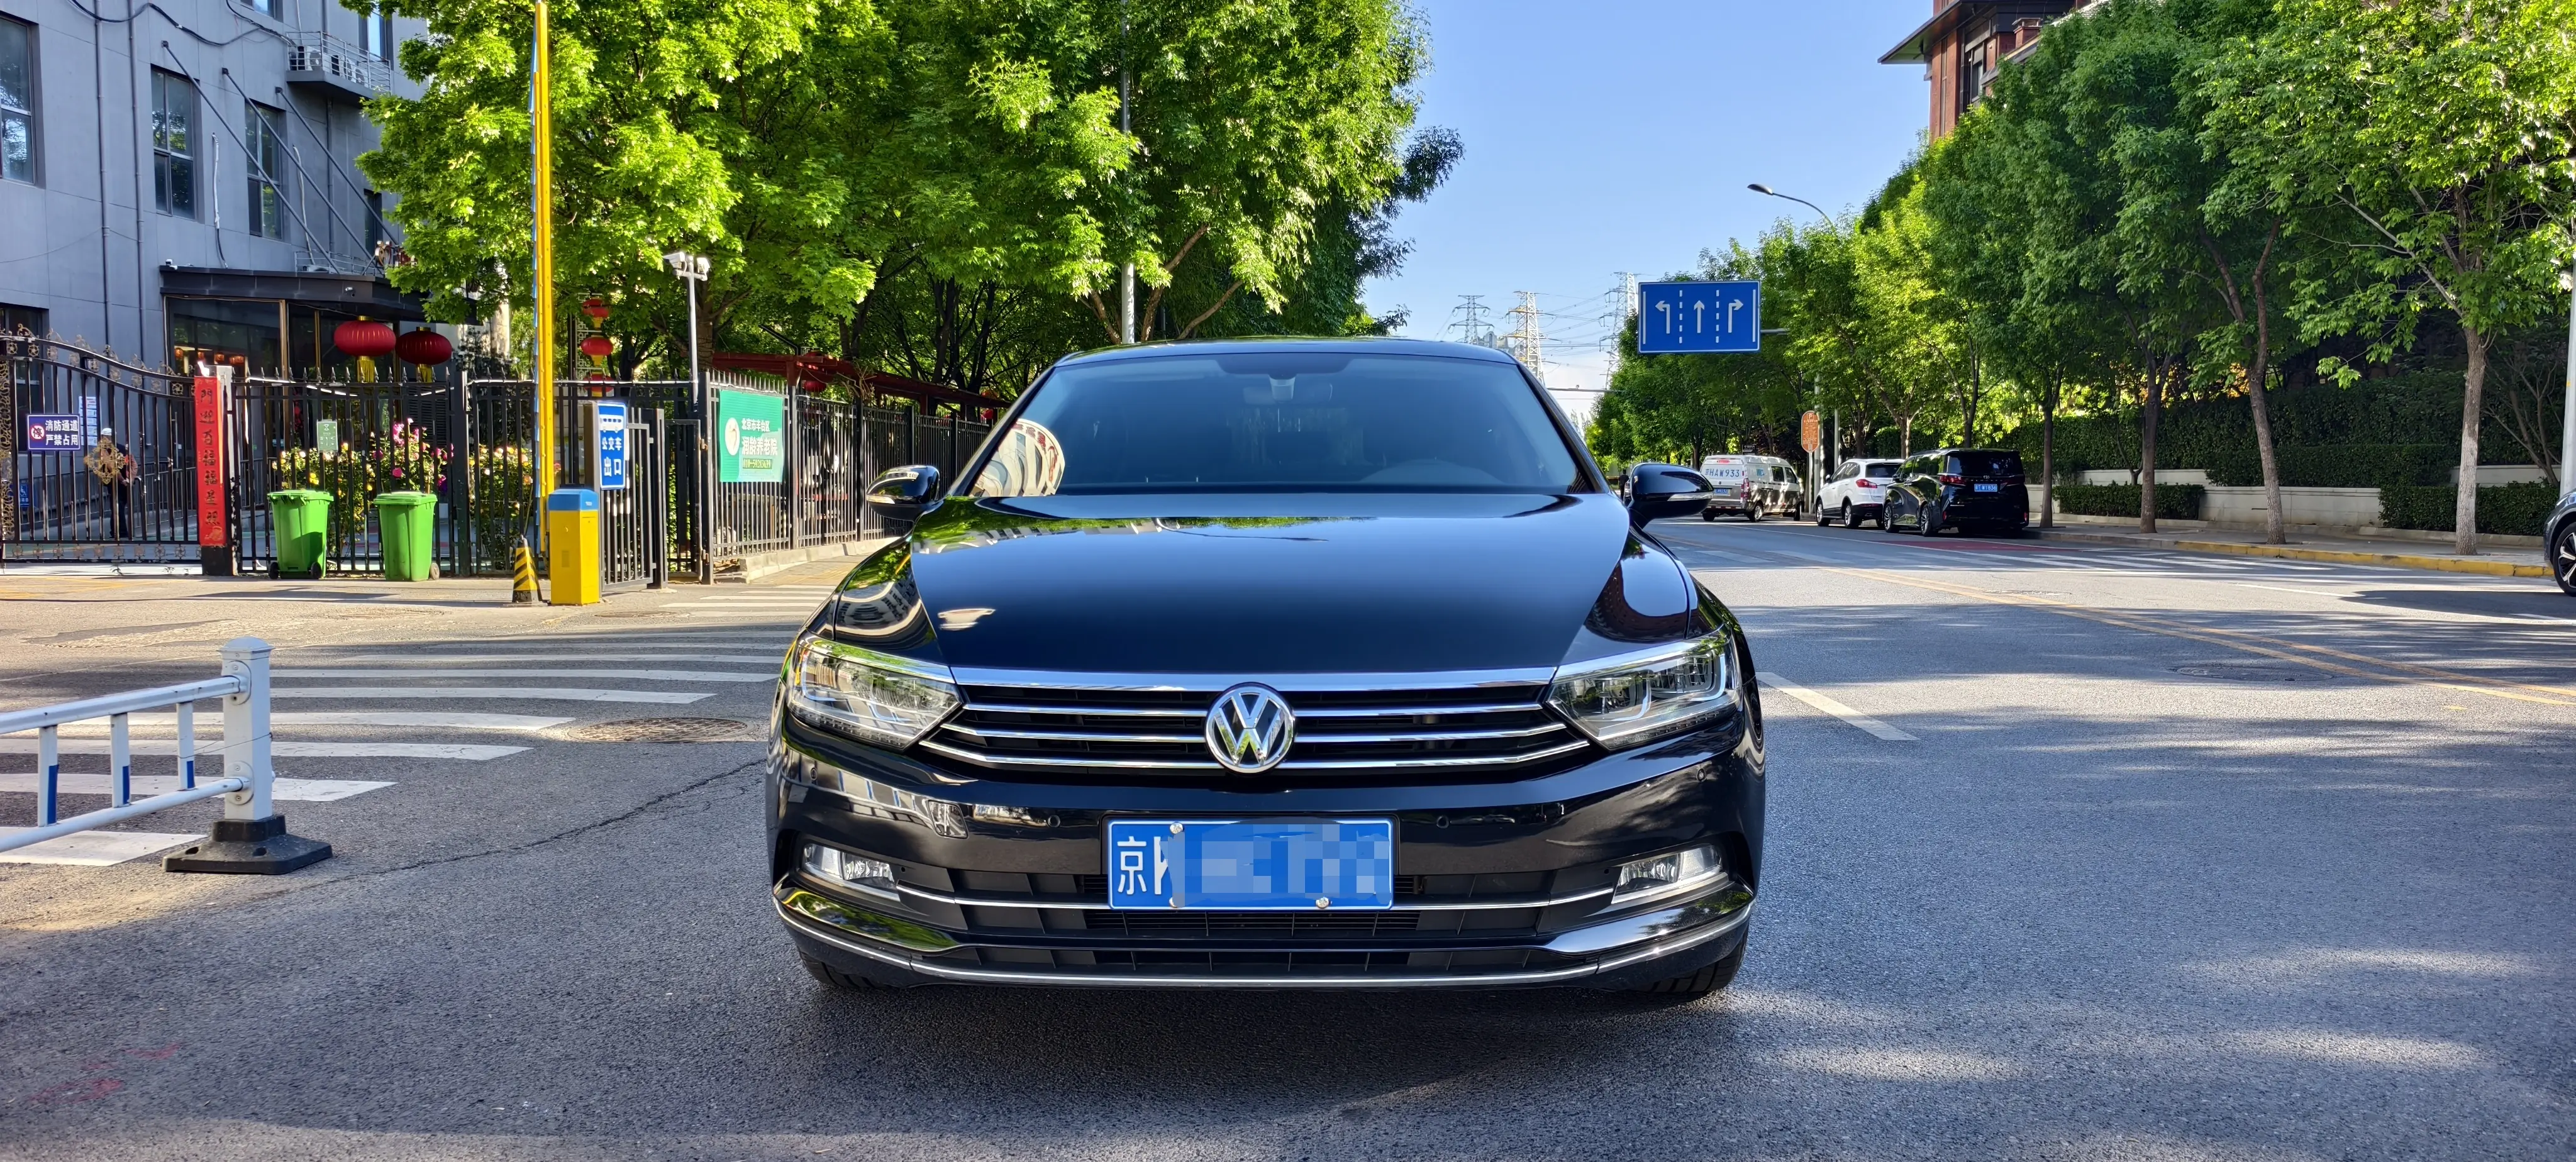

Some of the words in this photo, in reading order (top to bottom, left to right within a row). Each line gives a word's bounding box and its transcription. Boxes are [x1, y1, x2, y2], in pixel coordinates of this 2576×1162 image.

[45, 420, 79, 431] 消防通道
[45, 434, 79, 446] 严禁占用
[602, 436, 622, 451] 公交车
[604, 456, 622, 477] 出口
[1211, 689, 1288, 767] VW
